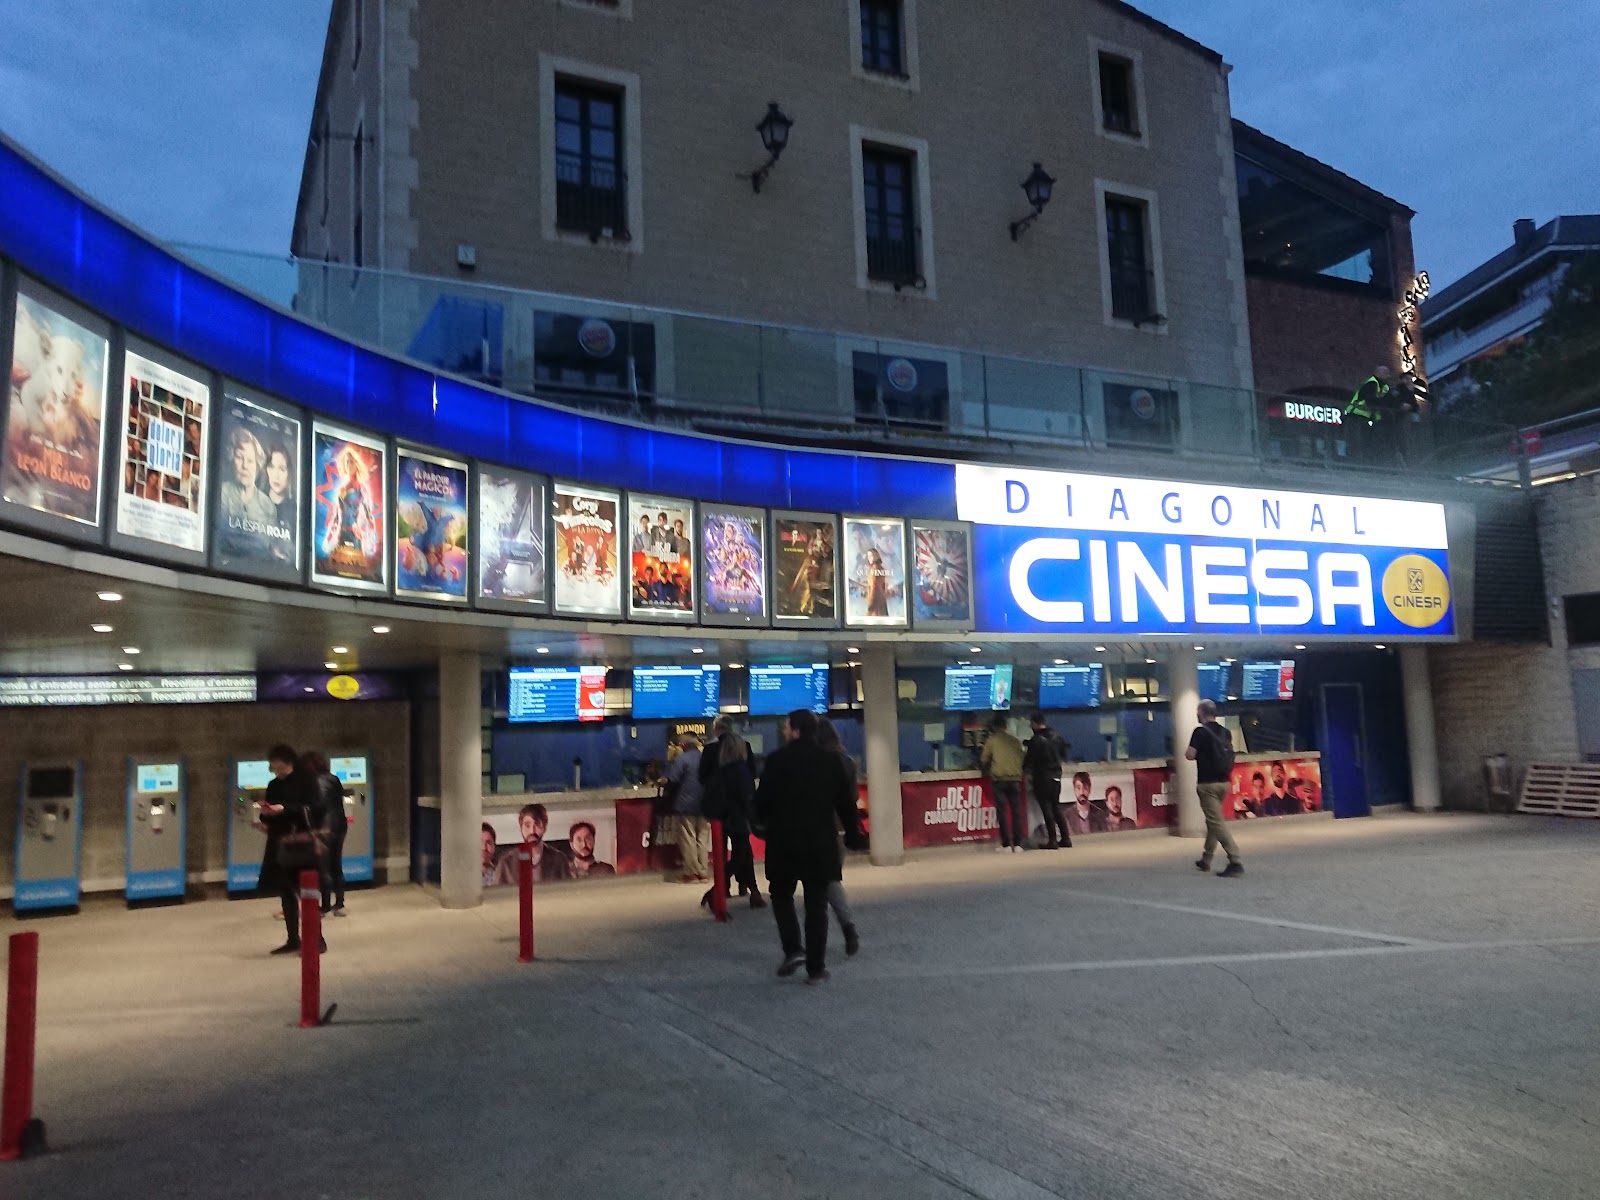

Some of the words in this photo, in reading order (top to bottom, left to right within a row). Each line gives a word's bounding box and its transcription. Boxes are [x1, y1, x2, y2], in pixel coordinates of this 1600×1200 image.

[1285, 402, 1342, 424] BURGER
[150, 419, 176, 443] dolor
[149, 442, 181, 473] gloria
[1005, 480, 1366, 535] DIAGONAL
[266, 524, 291, 541] ROJA
[1008, 537, 1376, 626] CINESA
[1393, 594, 1443, 609] CINESA
[936, 796, 947, 810] LO
[947, 785, 982, 809] DEJO
